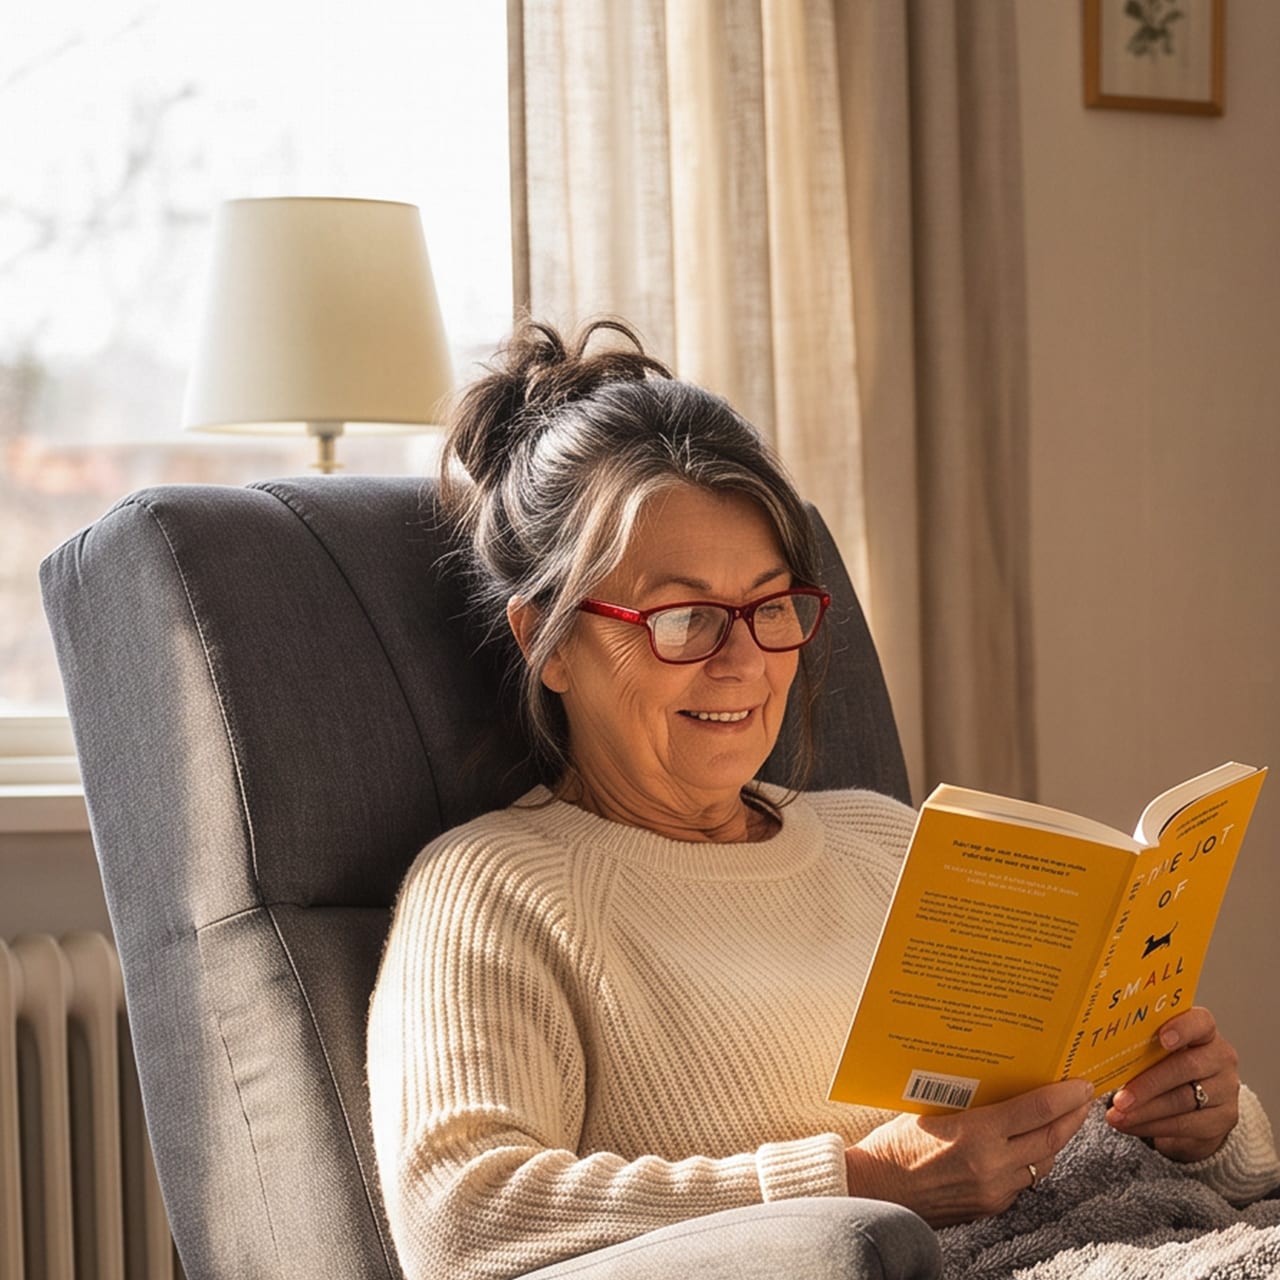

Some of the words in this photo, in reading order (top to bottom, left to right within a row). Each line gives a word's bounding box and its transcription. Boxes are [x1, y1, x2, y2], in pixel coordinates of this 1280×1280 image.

[1158, 879, 1189, 908] OF
[1108, 956, 1184, 1010] SMALL
[1090, 988, 1183, 1047] THINGS
